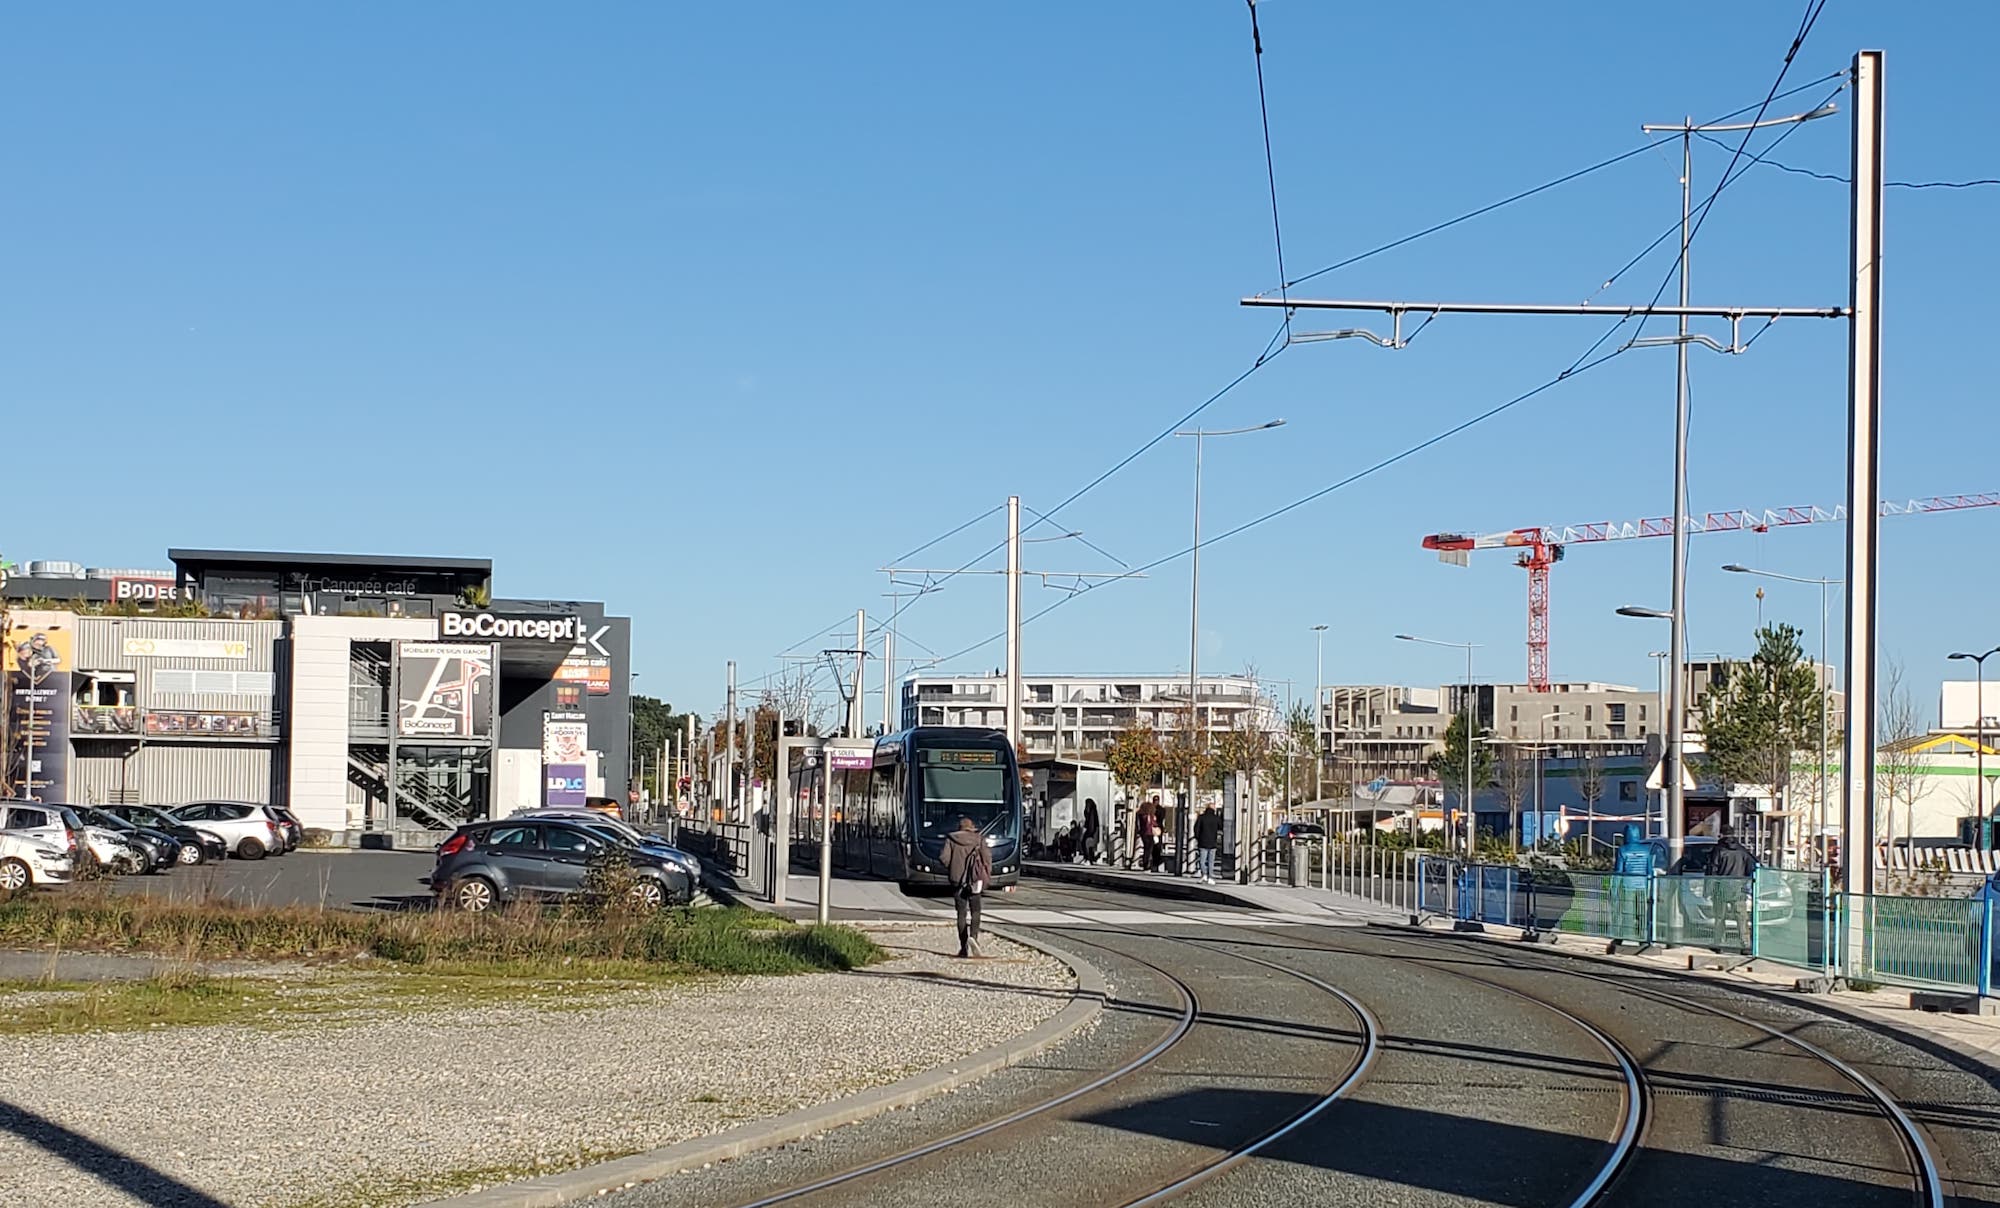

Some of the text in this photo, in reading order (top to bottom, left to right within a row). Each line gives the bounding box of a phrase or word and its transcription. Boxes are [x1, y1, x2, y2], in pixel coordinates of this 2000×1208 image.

[321, 577, 415, 596] Canopée café
[443, 612, 574, 642] BoConcept
[404, 720, 453, 729] BoConcept
[548, 777, 583, 789] LDLC
